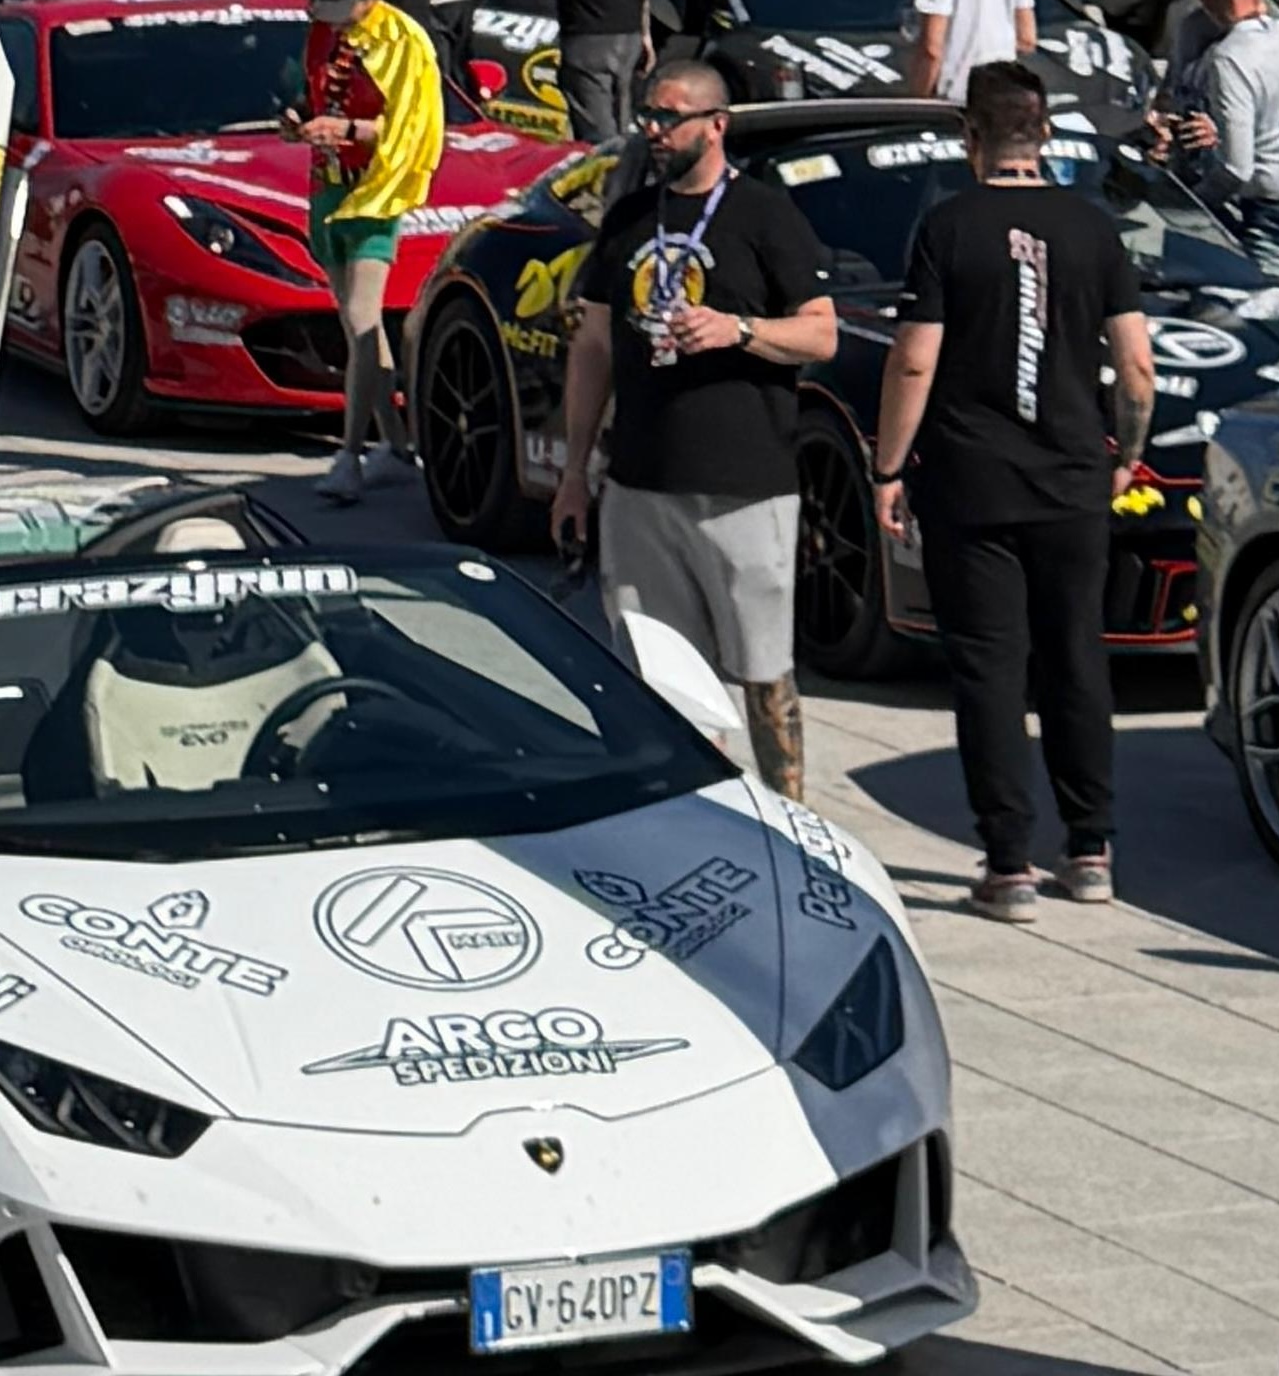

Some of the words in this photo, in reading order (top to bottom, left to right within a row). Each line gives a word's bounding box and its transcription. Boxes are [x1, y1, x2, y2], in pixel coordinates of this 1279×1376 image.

[19, 892, 289, 997] CONTE
[585, 856, 759, 970] CONTE
[381, 1007, 604, 1060] ARCO
[395, 1045, 618, 1086] SPEDIZIONI
